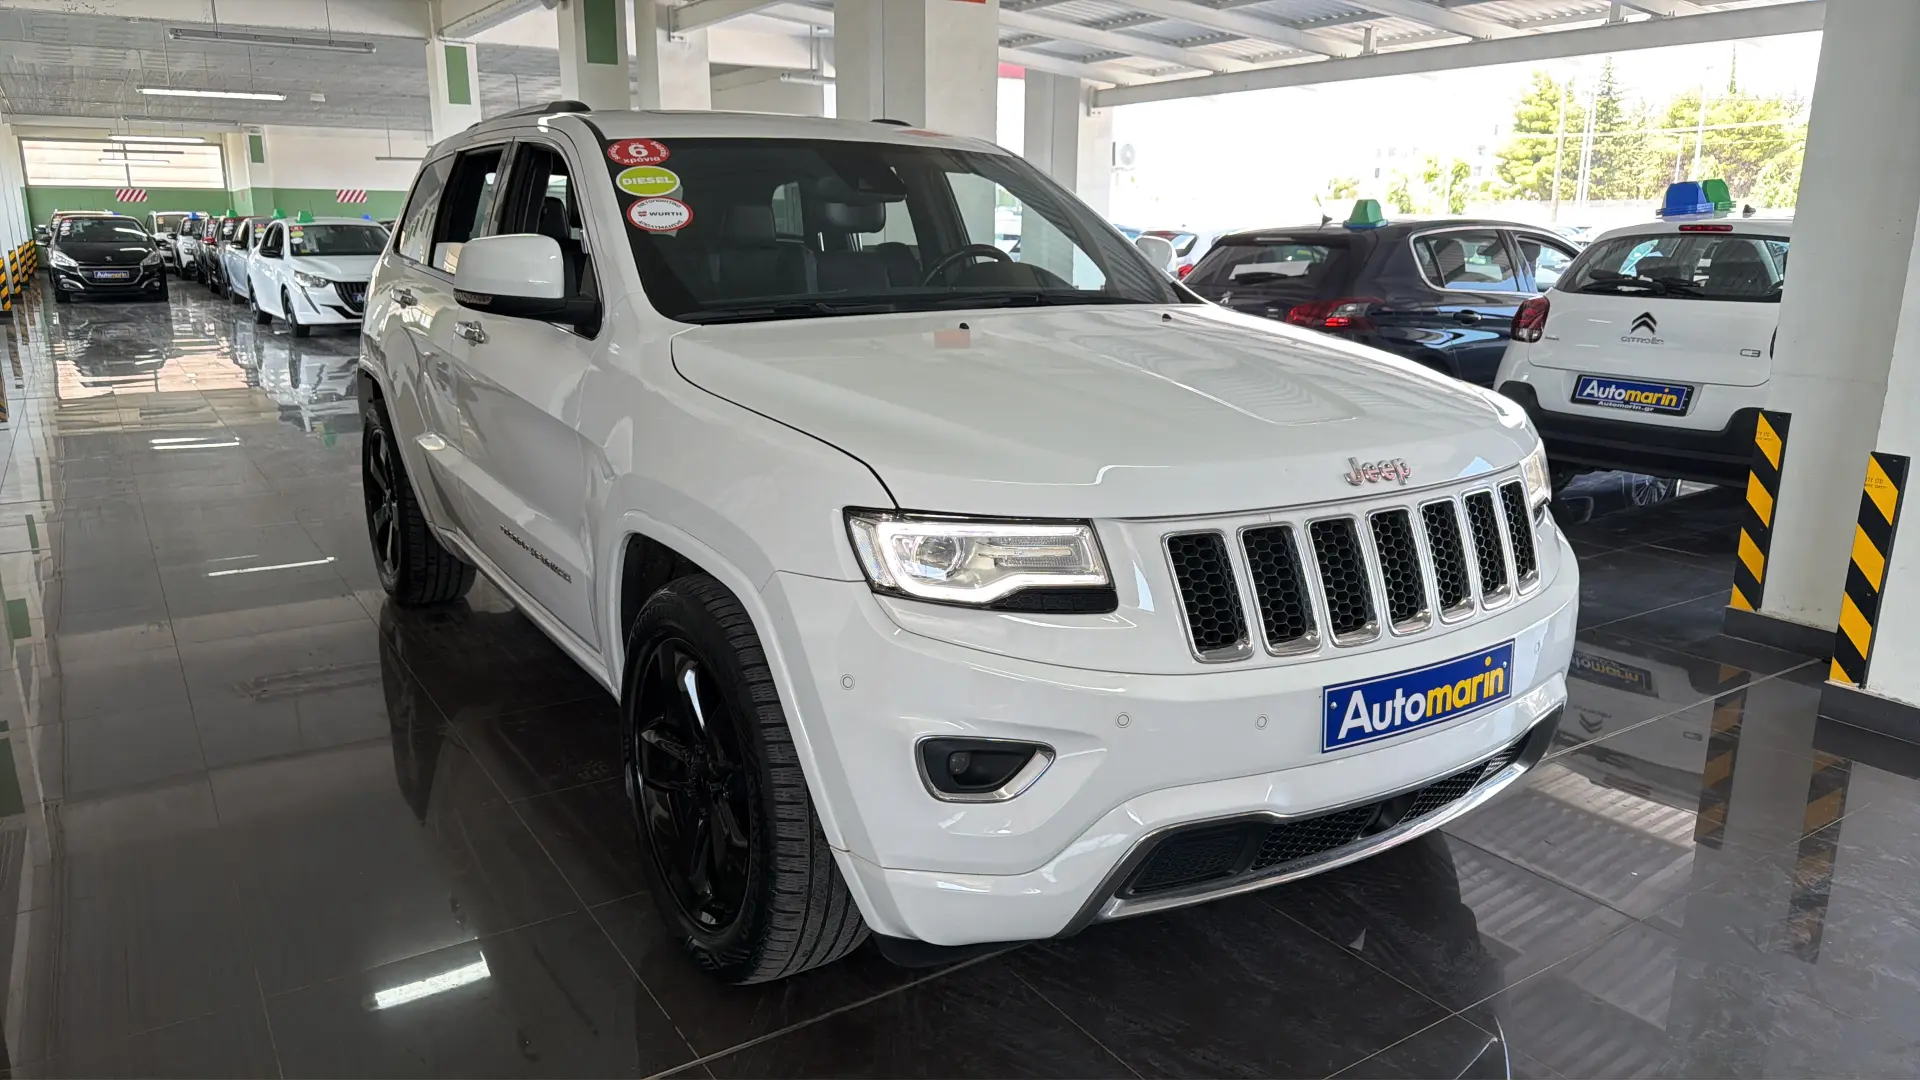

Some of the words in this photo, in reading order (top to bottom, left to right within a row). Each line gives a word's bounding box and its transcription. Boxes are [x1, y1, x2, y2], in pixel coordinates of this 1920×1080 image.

[628, 144, 649, 158] 6
[622, 177, 674, 185] DIESEL
[1739, 347, 1761, 358] C3
[1582, 379, 1678, 407] Automarin
[1597, 400, 1655, 412] Automarin.gr
[1343, 456, 1412, 486] Jeep
[1337, 656, 1505, 740] Automarin
